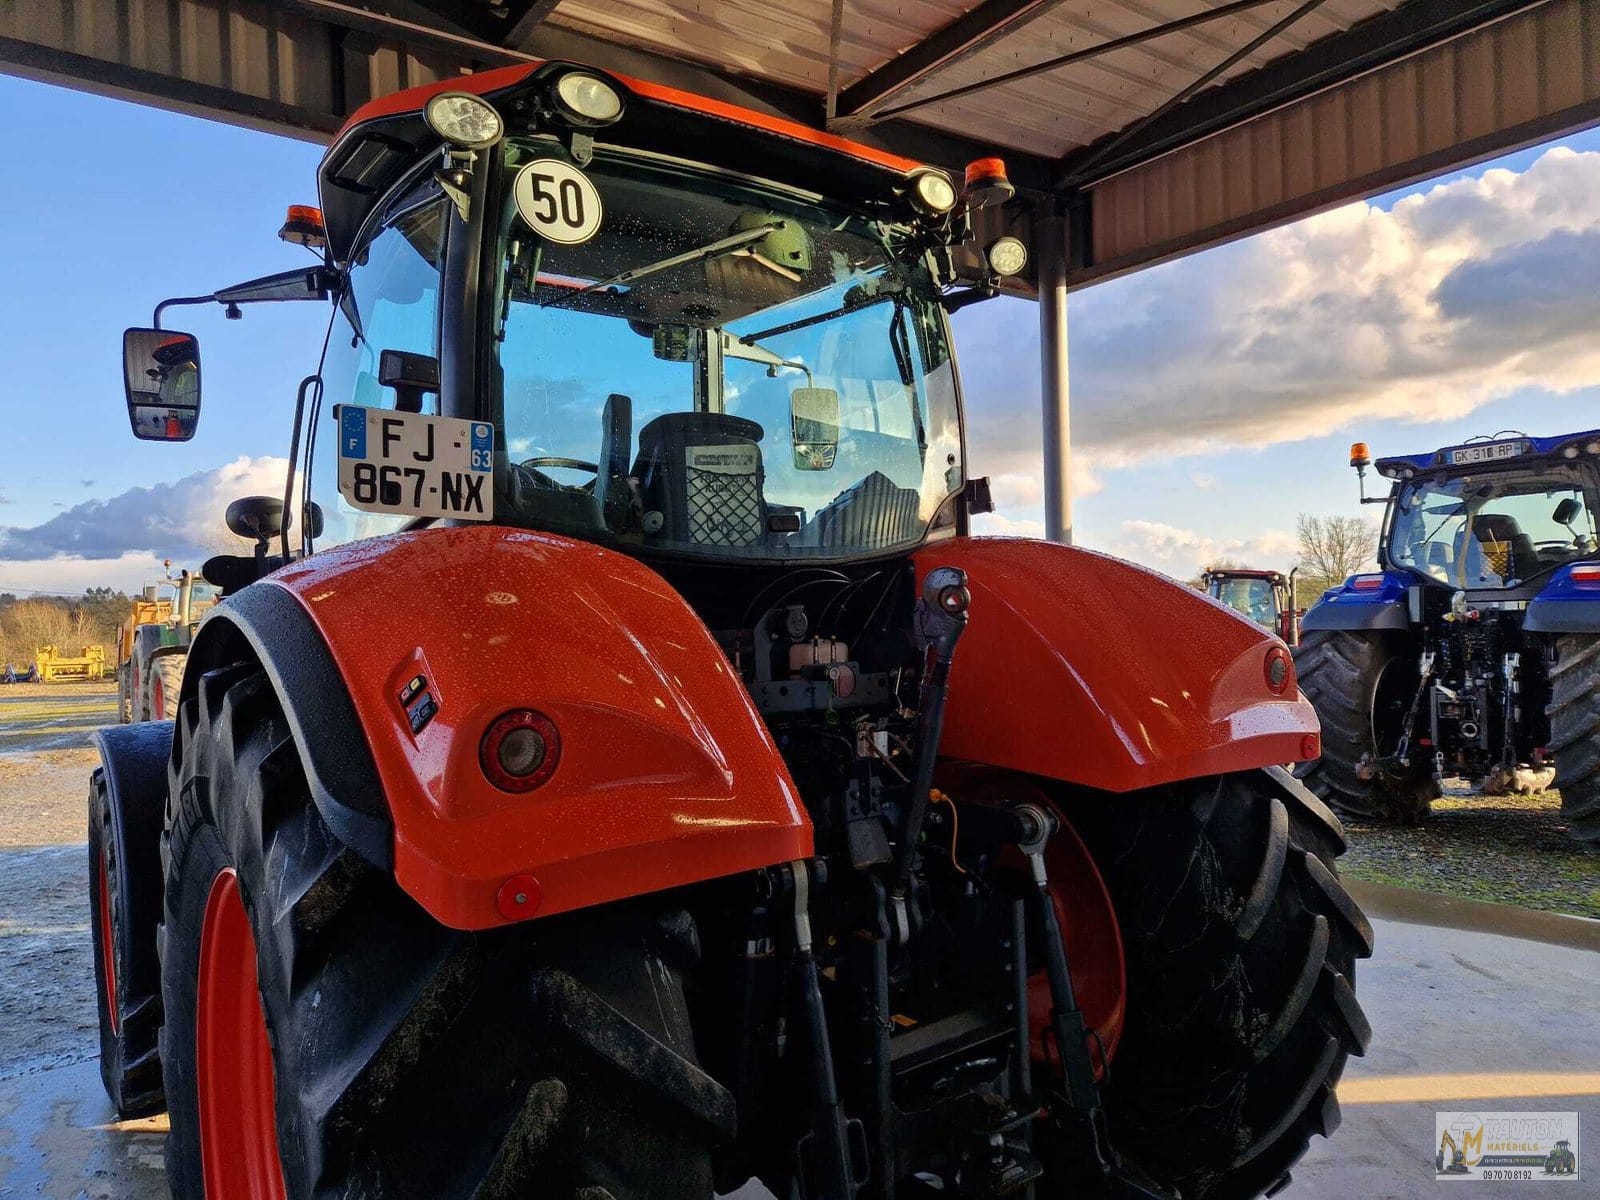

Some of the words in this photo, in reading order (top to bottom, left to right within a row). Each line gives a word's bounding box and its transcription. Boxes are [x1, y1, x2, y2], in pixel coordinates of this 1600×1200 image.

[531, 172, 585, 229] 50
[349, 438, 358, 450] F
[471, 448, 492, 468] 63
